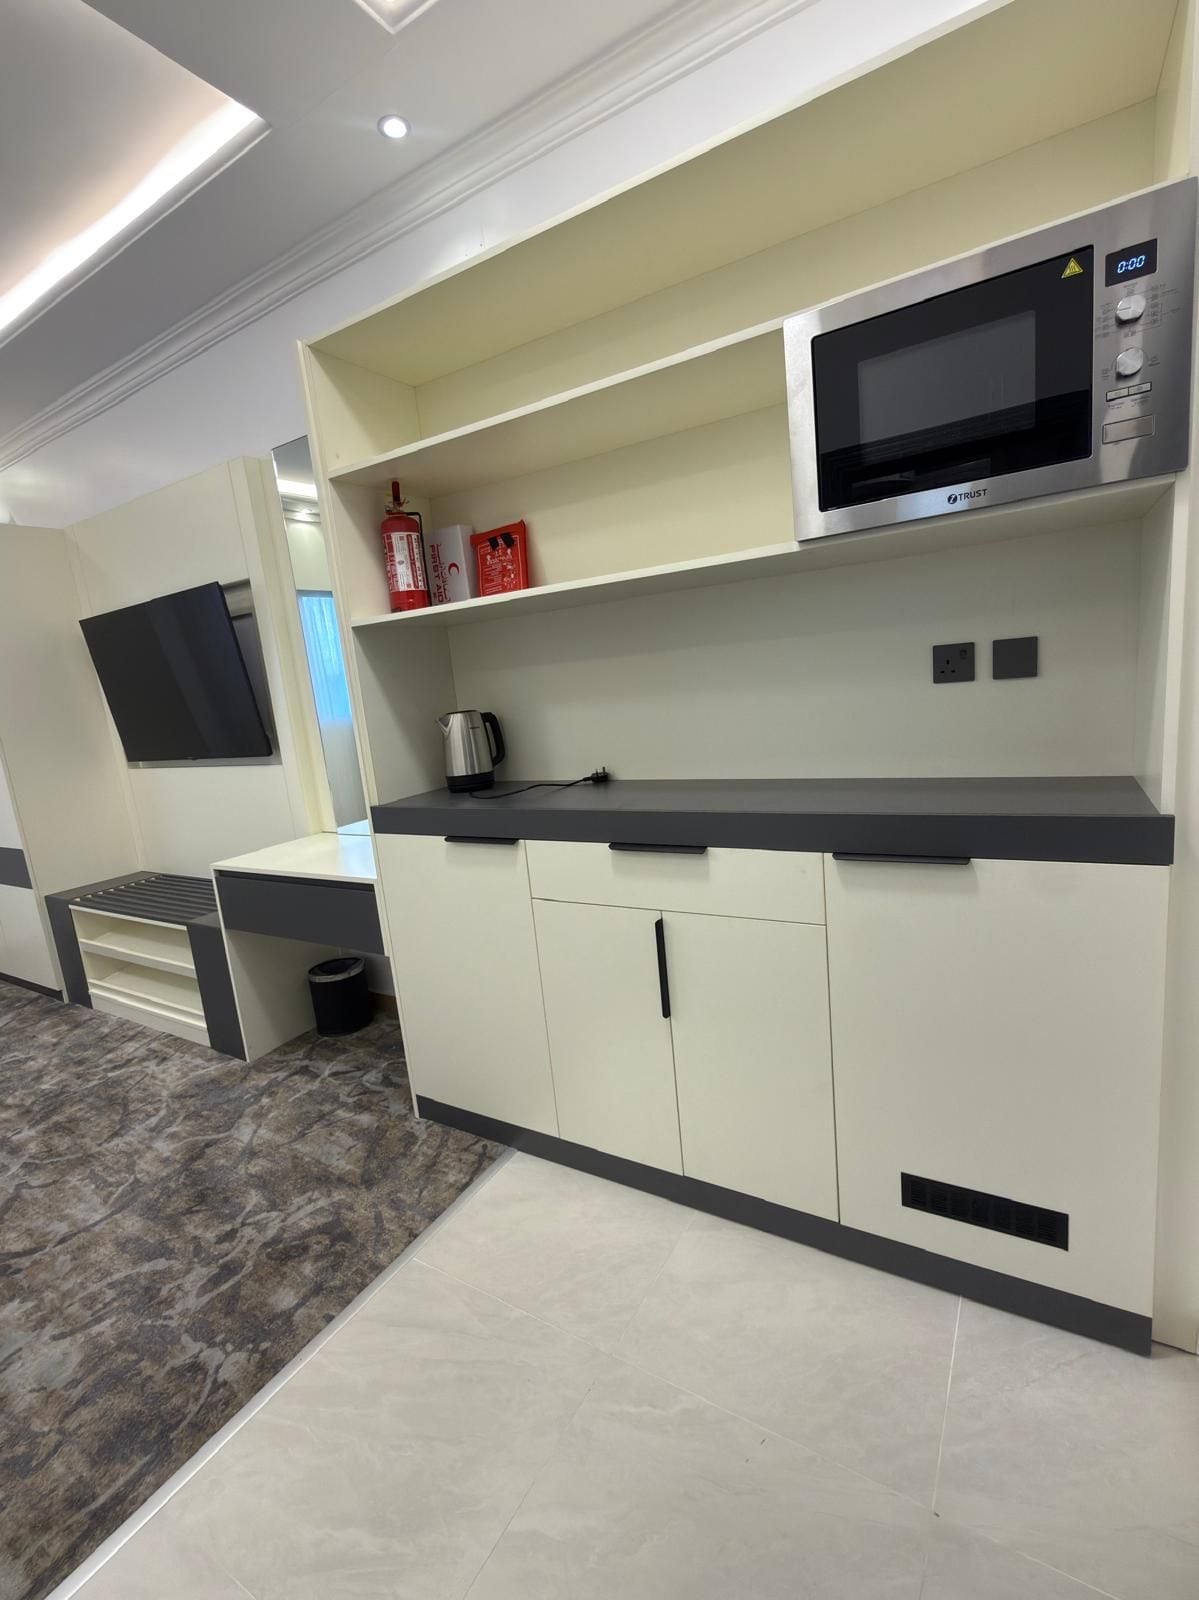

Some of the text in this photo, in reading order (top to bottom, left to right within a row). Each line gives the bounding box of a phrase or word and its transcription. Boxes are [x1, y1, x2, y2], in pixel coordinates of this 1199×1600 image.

[1117, 255, 1146, 274] 0:00
[958, 488, 988, 501] TRUST
[429, 544, 444, 603] FIRST AID
